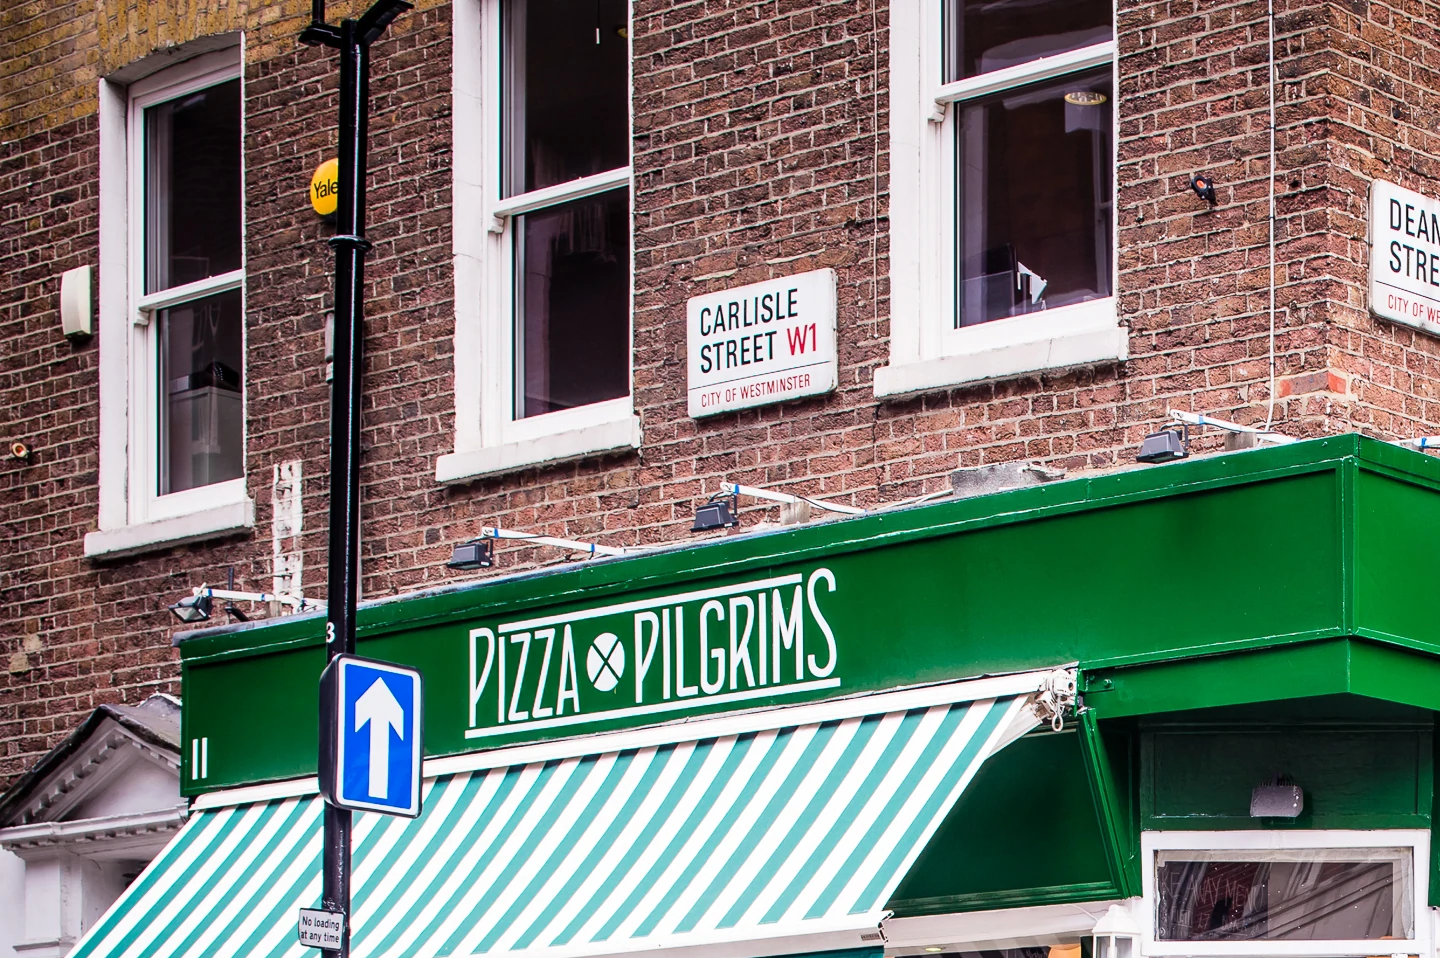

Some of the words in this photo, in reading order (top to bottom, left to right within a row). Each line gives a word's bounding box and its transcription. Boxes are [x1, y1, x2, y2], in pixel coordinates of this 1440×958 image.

[313, 178, 338, 199] Yale
[700, 288, 798, 336] CARLISLE
[1388, 294, 1409, 314] CITY
[1412, 302, 1424, 317] OF
[700, 330, 777, 373] STREET
[786, 323, 816, 355] W1
[701, 392, 721, 408] CITY
[725, 387, 737, 402] OF
[739, 373, 811, 399] WESTMINSTER
[469, 624, 580, 728] PIZZA
[634, 567, 838, 703] PILGRIMS
[301, 931, 308, 939] at
[309, 932, 322, 943] any
[324, 932, 340, 943] time
[302, 916, 312, 926] No
[314, 917, 340, 932] loading
